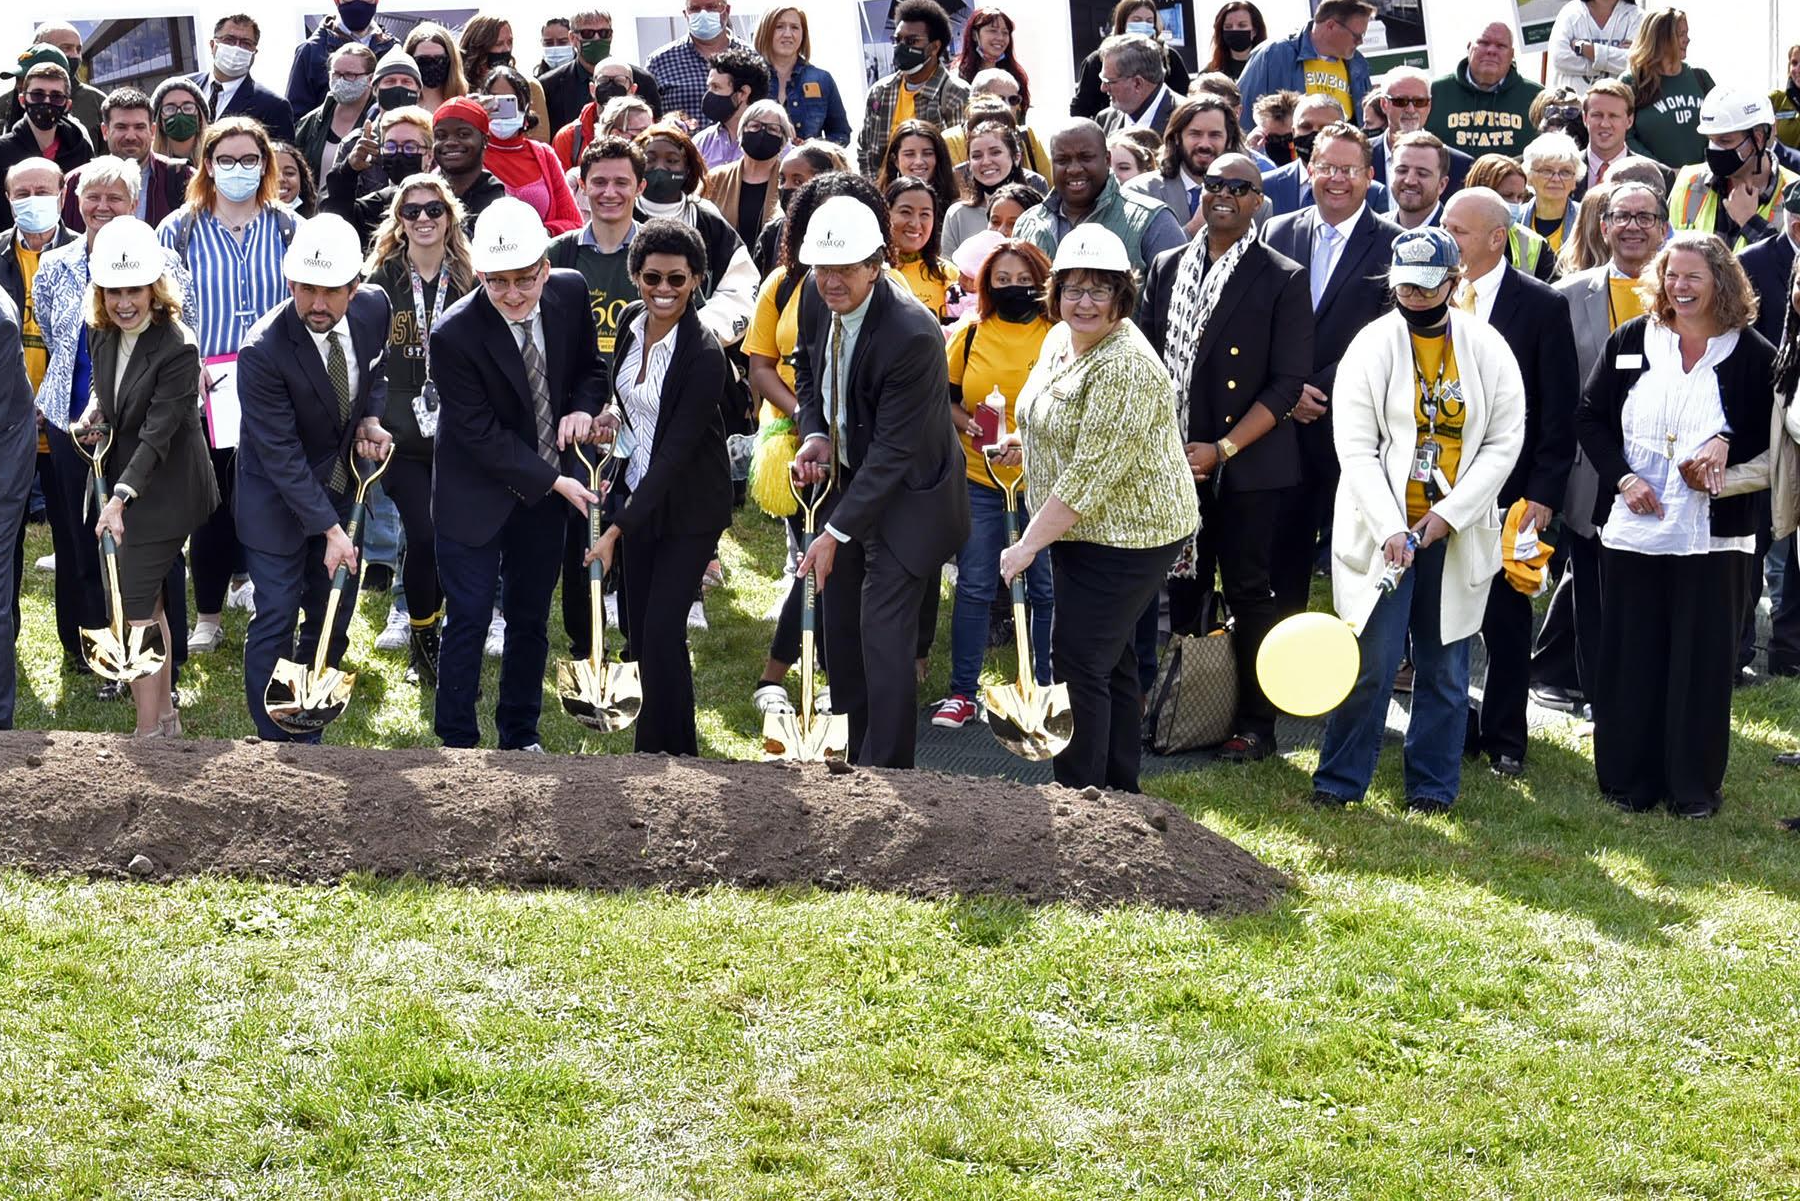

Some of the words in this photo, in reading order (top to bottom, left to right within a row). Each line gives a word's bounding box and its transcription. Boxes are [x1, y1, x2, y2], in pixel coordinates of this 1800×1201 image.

[1304, 71, 1351, 92] SWEG
[1653, 95, 1705, 114] WOMAN
[1448, 110, 1522, 130] OSWEGO
[1675, 110, 1693, 124] UP
[1456, 130, 1514, 147] STATE
